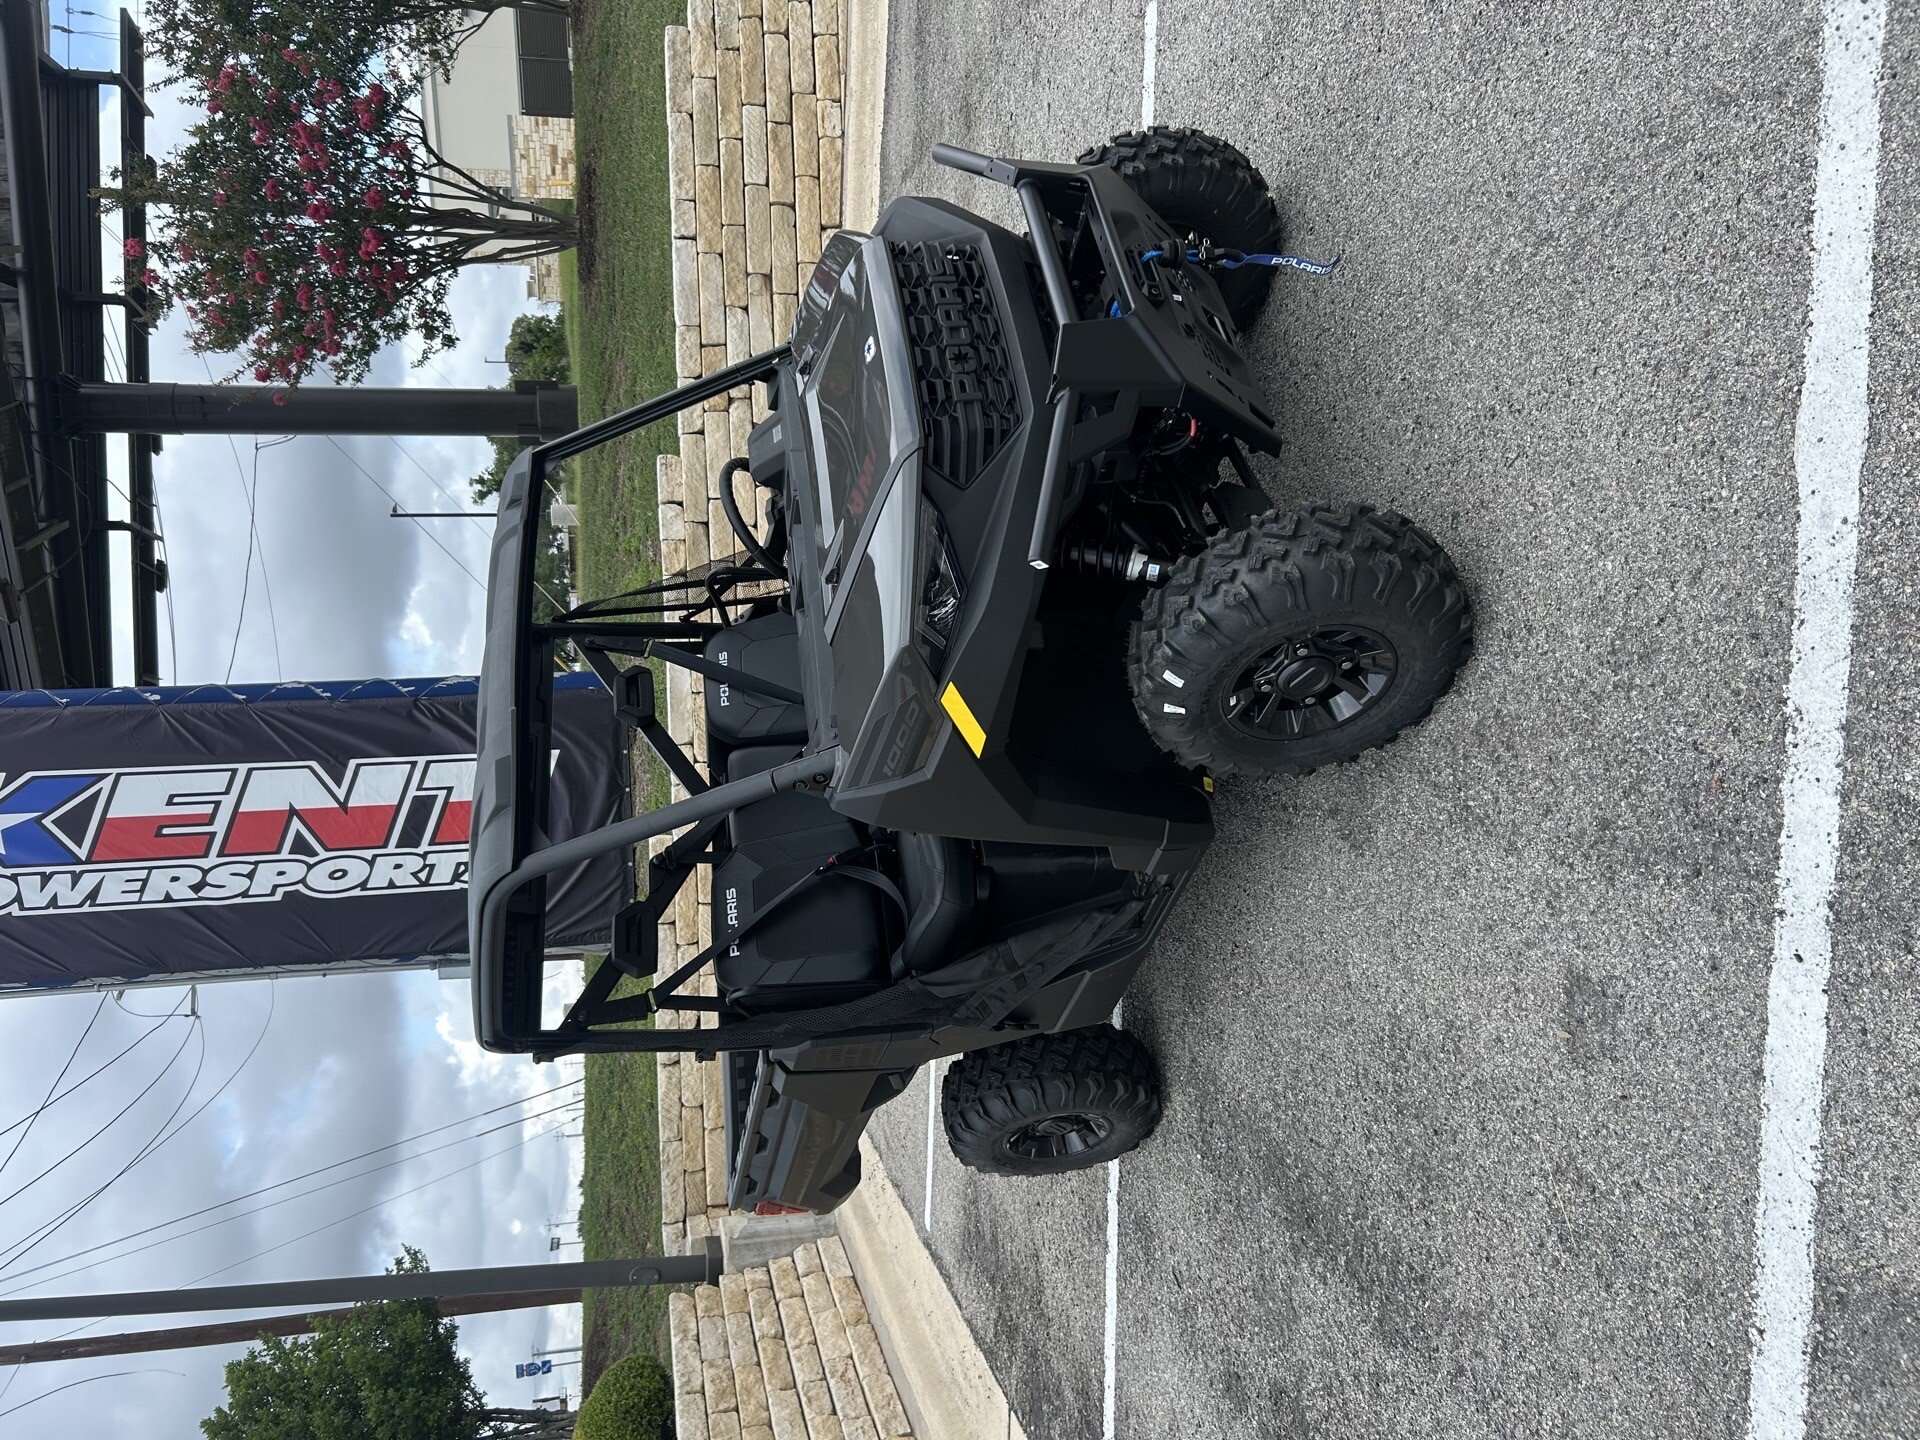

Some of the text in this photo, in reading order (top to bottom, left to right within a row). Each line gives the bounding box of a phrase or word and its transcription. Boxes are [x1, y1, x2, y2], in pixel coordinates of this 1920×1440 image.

[924, 256, 983, 403] POLARIS
[718, 651, 730, 707] POLIS
[882, 700, 920, 777] 1000
[0, 852, 468, 912] WERSPORT
[726, 887, 740, 957] PARIS
